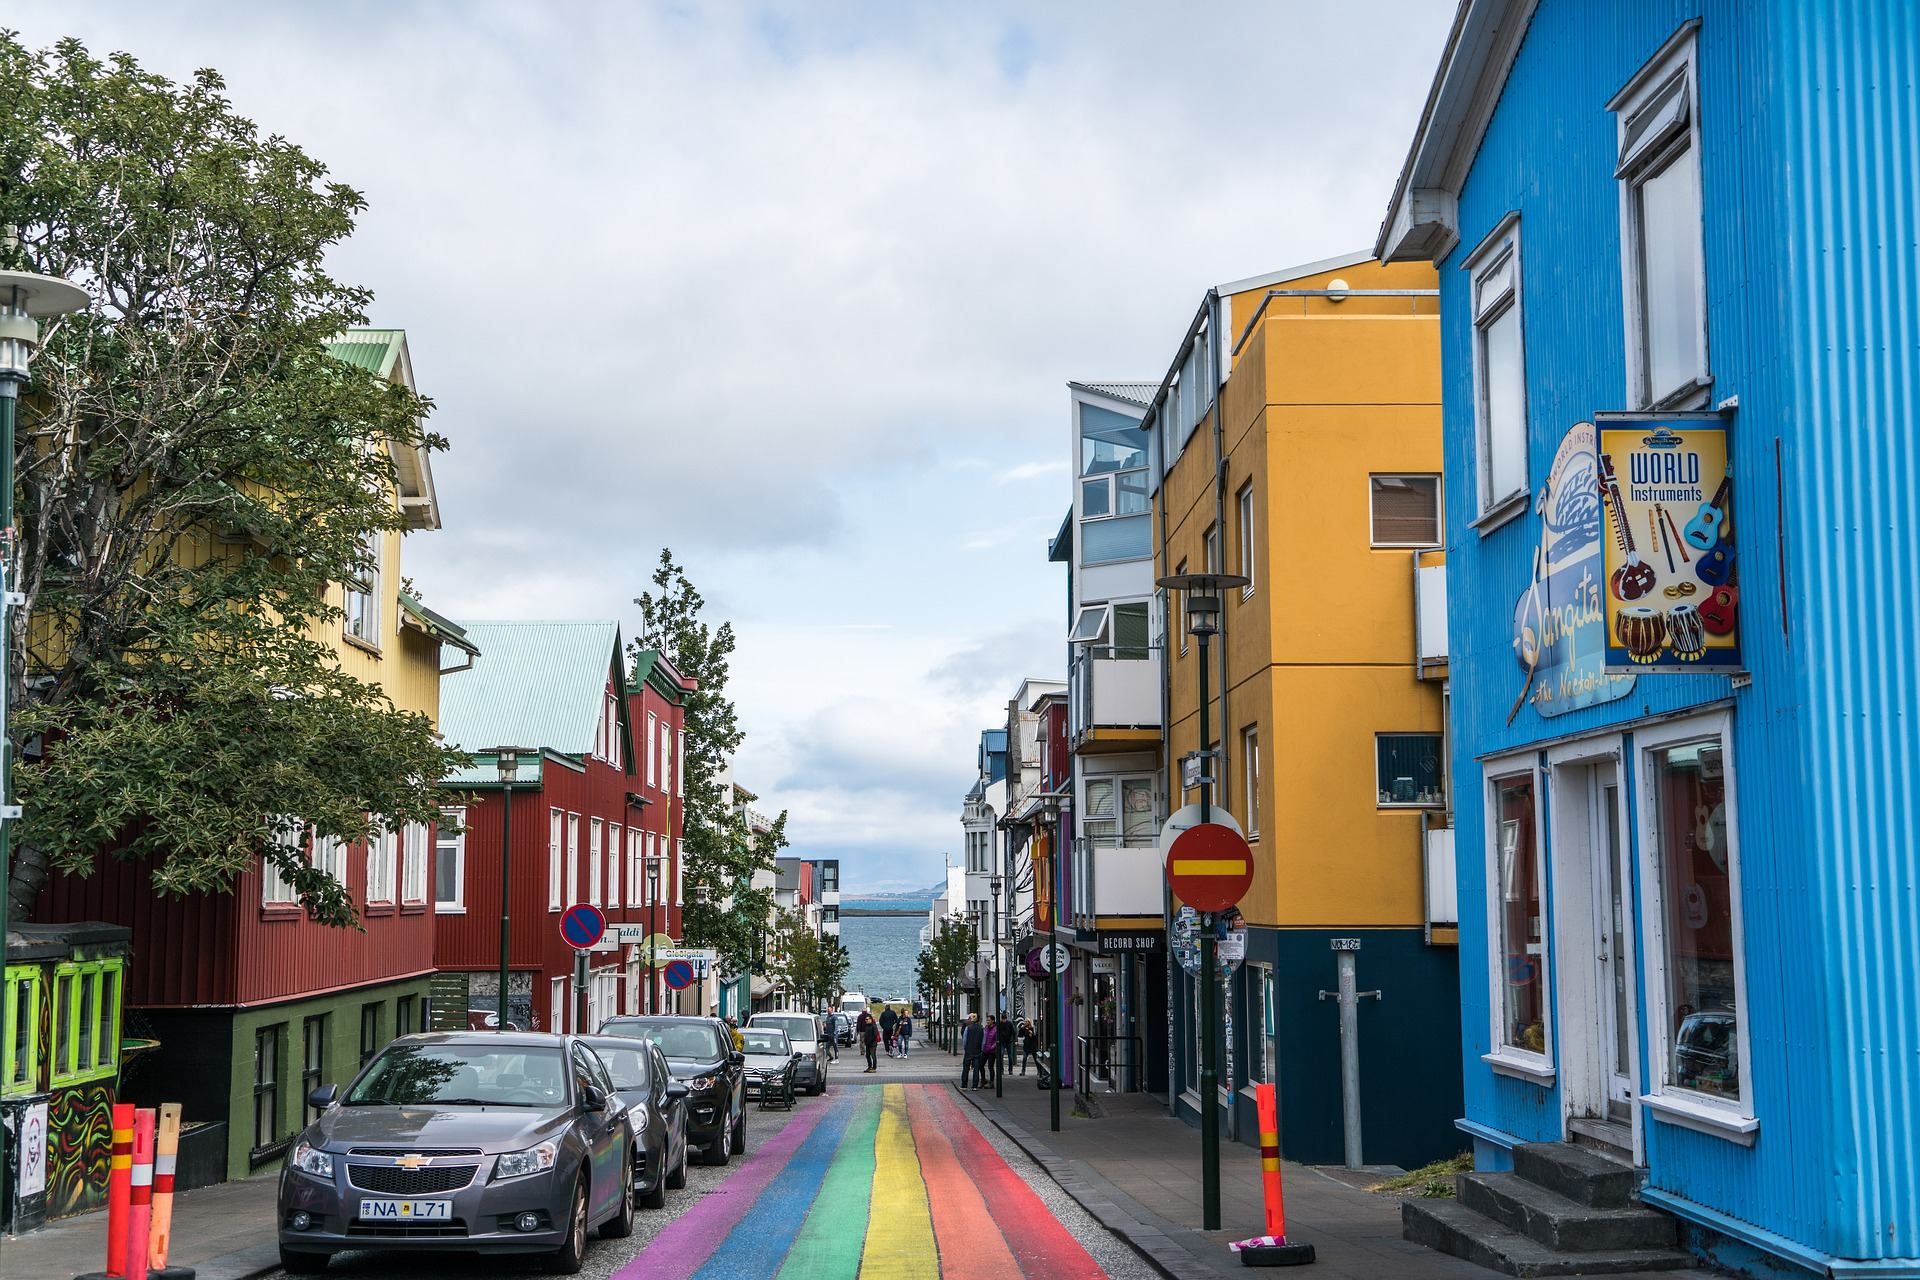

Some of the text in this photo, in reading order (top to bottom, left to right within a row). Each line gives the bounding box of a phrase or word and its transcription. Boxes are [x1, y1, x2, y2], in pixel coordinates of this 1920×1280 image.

[1630, 452, 1699, 485] WORLD
[1630, 484, 1702, 502] Instruments
[620, 927, 640, 937] aldi
[1104, 937, 1155, 949] RECORD SHOP
[373, 1202, 398, 1217] NA
[413, 1202, 446, 1217] L71
